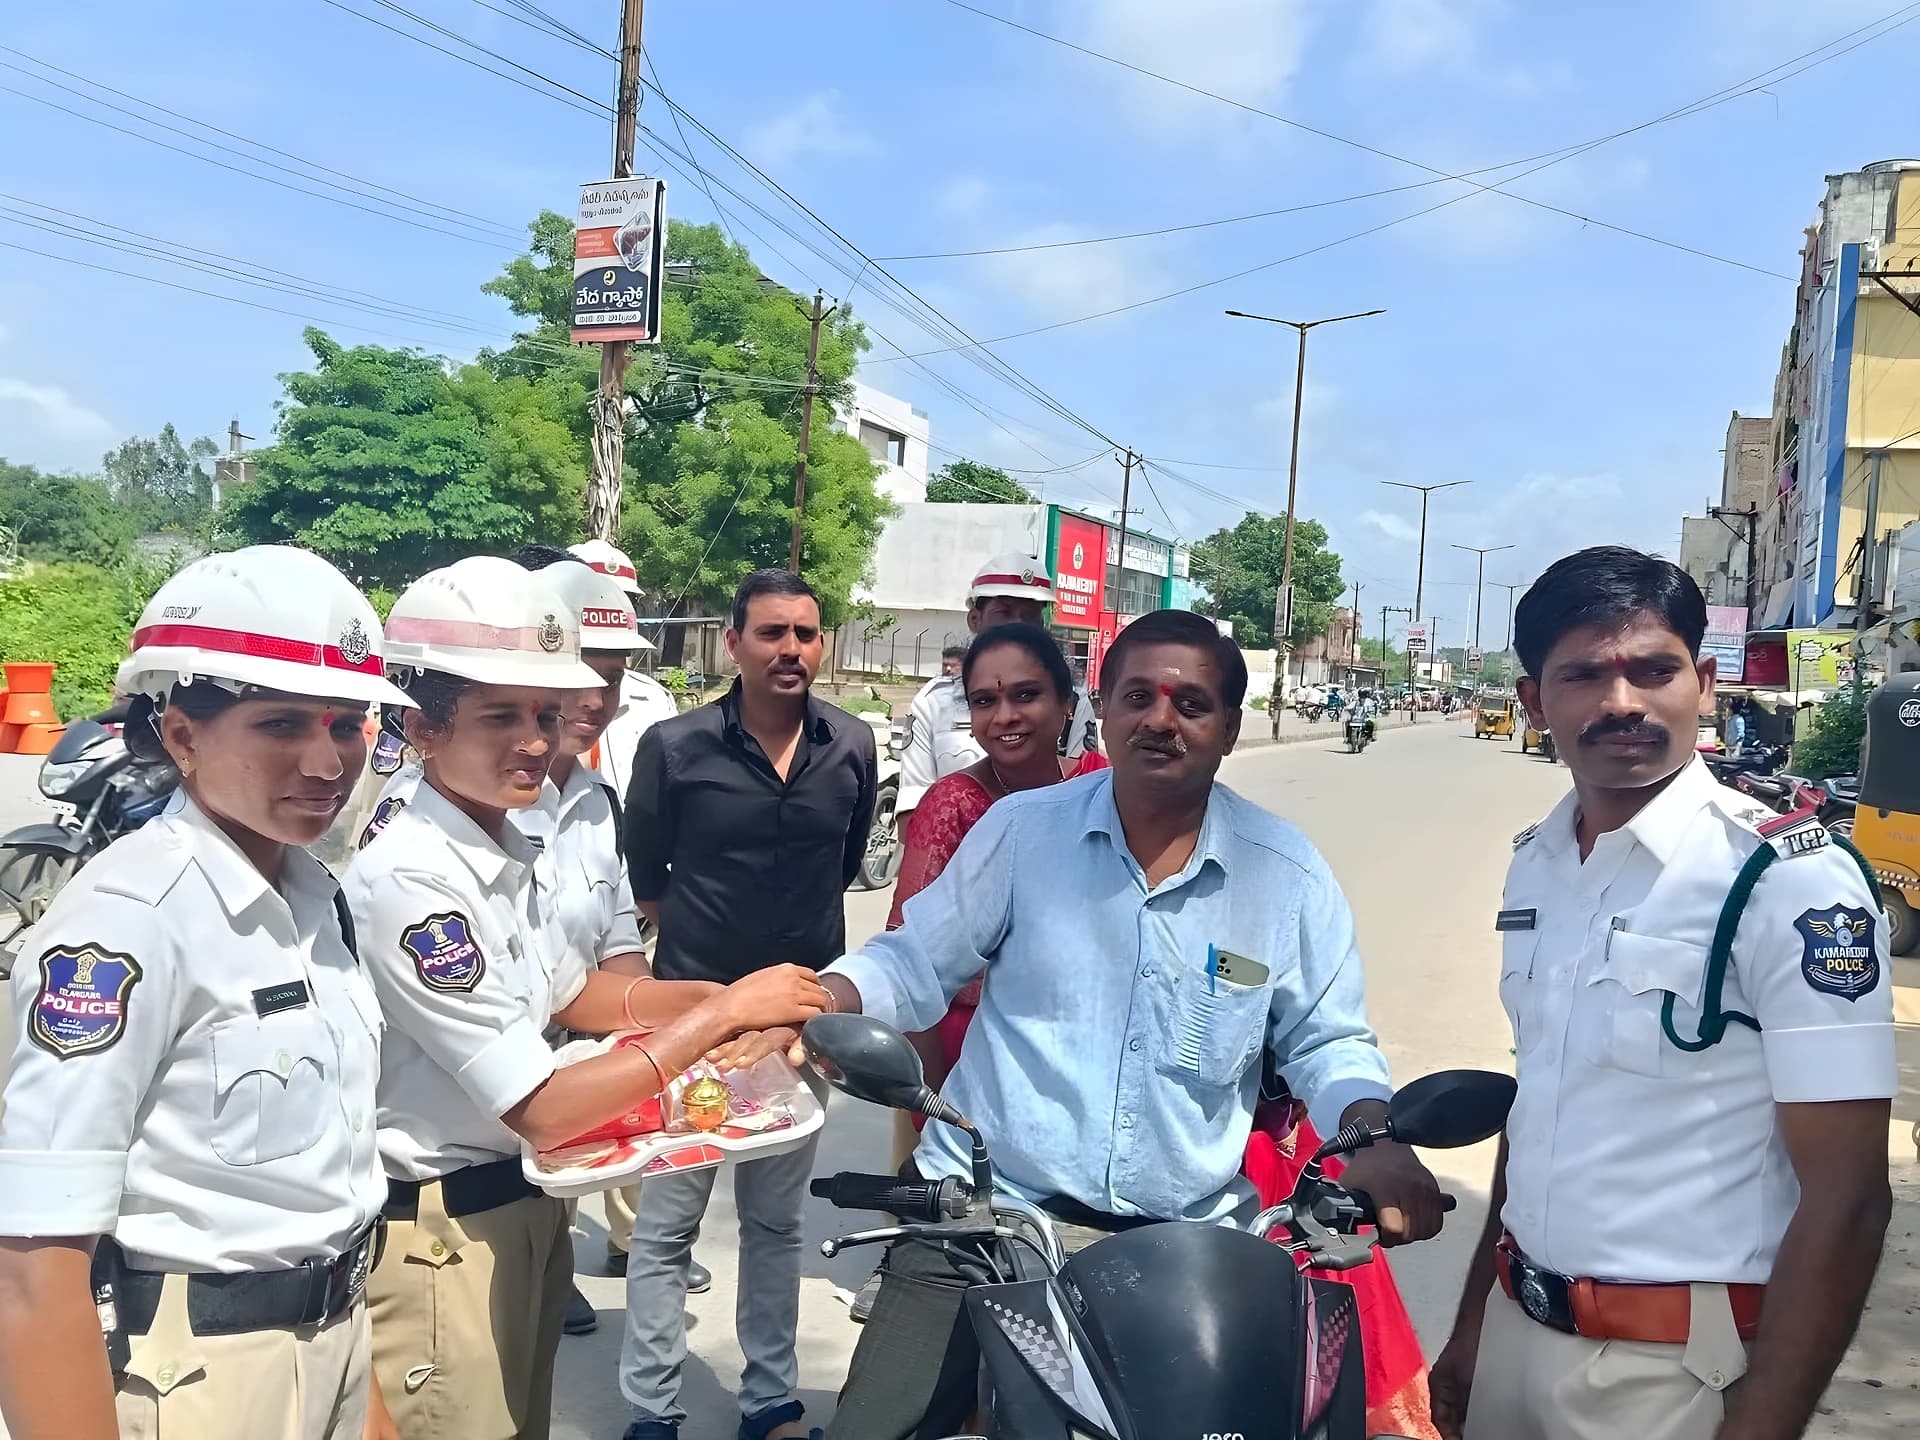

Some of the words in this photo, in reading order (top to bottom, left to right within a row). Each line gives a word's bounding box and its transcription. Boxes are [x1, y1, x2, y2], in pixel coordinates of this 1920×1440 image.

[576, 286, 600, 306] వేద
[582, 611, 628, 625] POLICE
[422, 942, 476, 969] POLICE
[1826, 958, 1865, 971] POLICE
[41, 992, 121, 1015] POLICE
